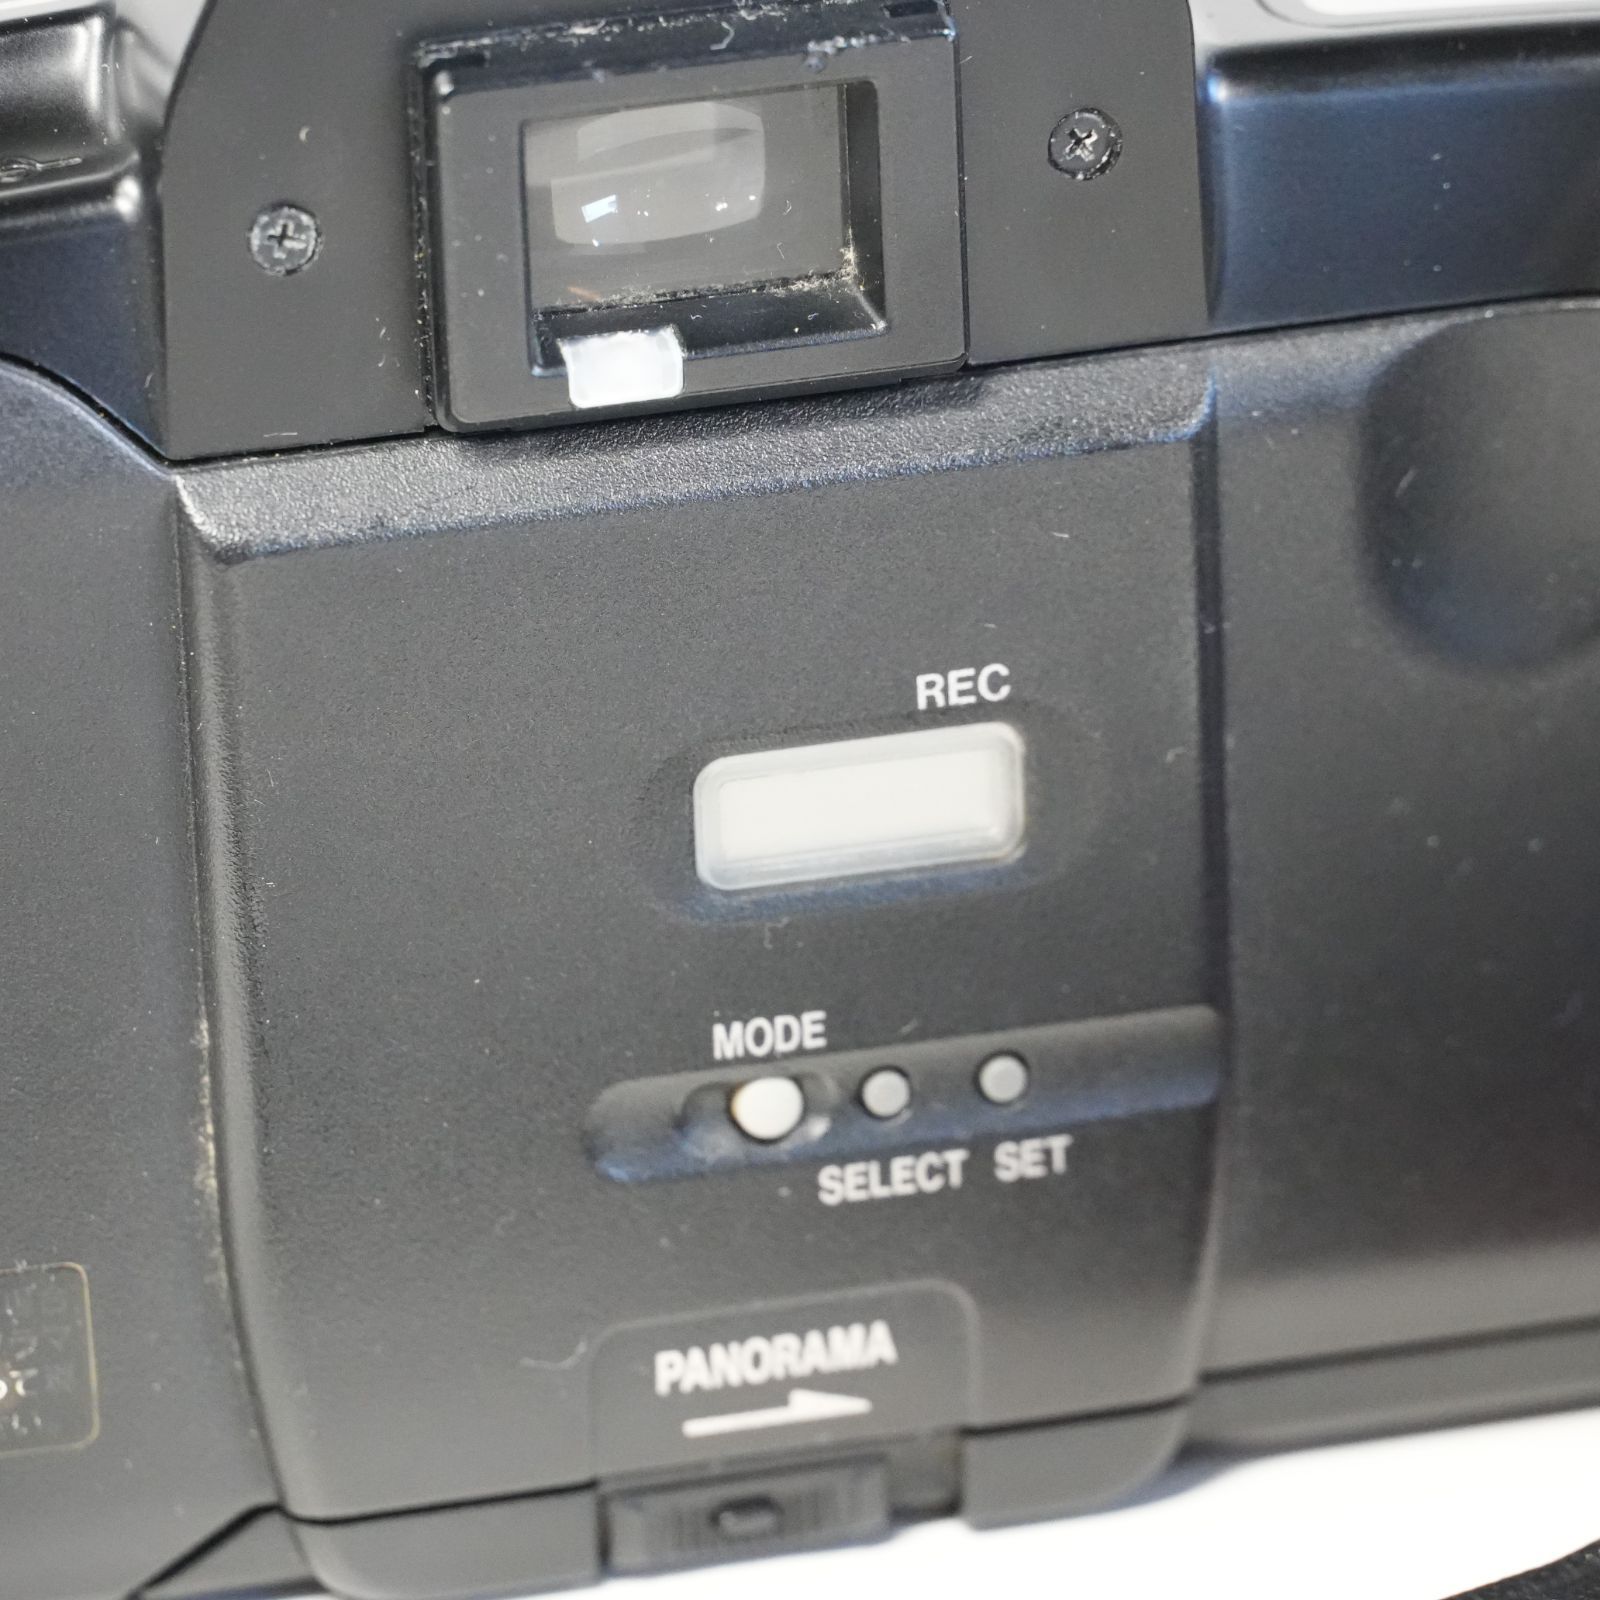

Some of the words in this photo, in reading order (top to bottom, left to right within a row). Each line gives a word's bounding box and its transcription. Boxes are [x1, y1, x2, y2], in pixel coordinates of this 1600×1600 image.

[916, 663, 1011, 711] REC
[712, 1011, 827, 1060] MODE
[817, 1147, 970, 1207] SELECT
[993, 1133, 1074, 1183] SET
[654, 1321, 897, 1395] PANORAMA
